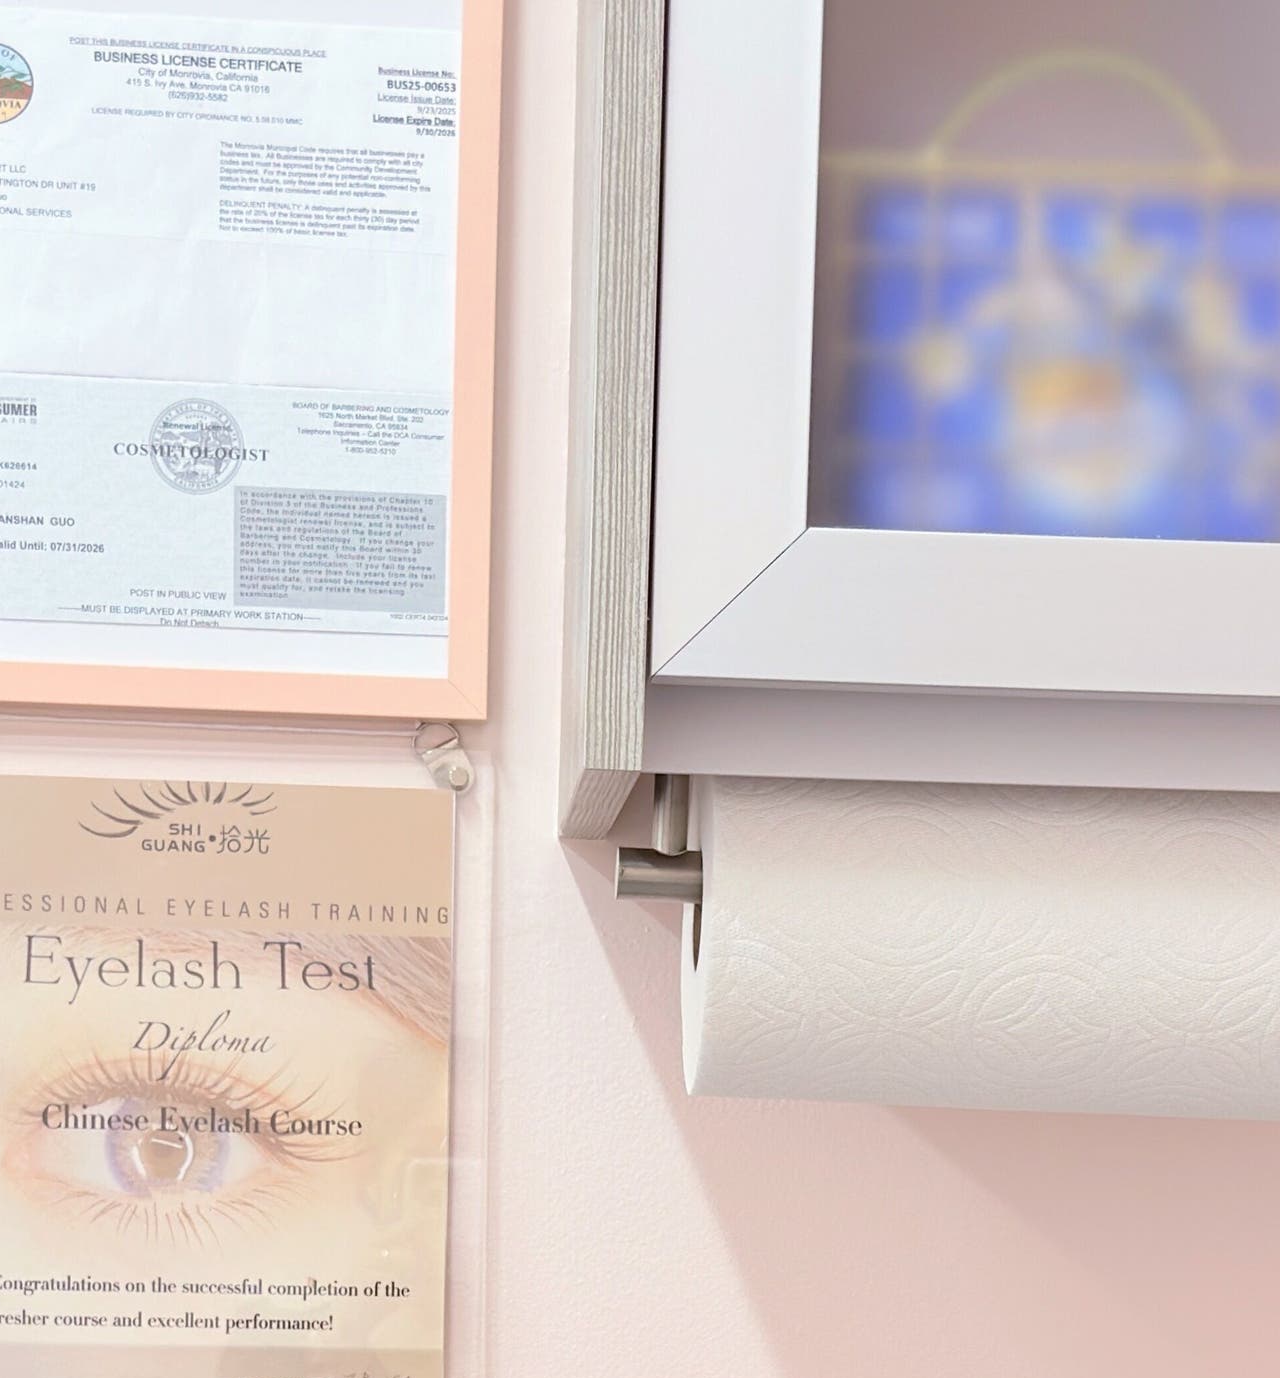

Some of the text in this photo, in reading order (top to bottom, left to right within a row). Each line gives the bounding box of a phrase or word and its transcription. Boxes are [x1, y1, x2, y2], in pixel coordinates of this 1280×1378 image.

[93, 50, 302, 73] BUSINESS LICENSE CERTIFICATE
[137, 66, 258, 82] City of Monrovia, California
[126, 77, 142, 86] 415
[154, 80, 167, 89] Ivy
[188, 82, 227, 91] Monrovia
[228, 83, 242, 92] CA
[244, 84, 270, 94] 91016
[386, 80, 456, 92] BUS25-00653
[372, 114, 404, 125] License
[8, 164, 26, 174] LLC
[40, 179, 54, 189] DR
[56, 180, 77, 190] UNIT
[79, 182, 96, 191] #19
[25, 207, 72, 218] SERVICES
[375, 405, 392, 413] AND
[392, 405, 449, 416] COSMETOLOGY
[113, 442, 269, 462] COSMETOLOGIST
[49, 516, 75, 527] GUO
[19, 540, 47, 551] Until:
[49, 541, 104, 553] 07/31/2026
[129, 587, 226, 600] POST IN PUBLIC VIEW
[81, 604, 303, 621] MUST BE DISPLAYED AT PRIMARY WORK STATION
[168, 823, 202, 836] SHI
[141, 839, 205, 853] GUANG
[218, 825, 271, 855] 拾光
[166, 897, 289, 920] EYELASH
[311, 902, 450, 925] TRAINING
[23, 934, 378, 1005] Eyelash Test
[132, 1009, 276, 1081] Diploma
[40, 1102, 363, 1138] Chinese Eyelash Course
[125, 1281, 145, 1293] on
[151, 1277, 176, 1293] the
[182, 1278, 262, 1295] successful
[267, 1279, 358, 1297] completion
[363, 1280, 381, 1297] of
[384, 1281, 410, 1298] the
[53, 1315, 107, 1327] course
[112, 1311, 142, 1328] and
[147, 1312, 219, 1329] excellent
[224, 1314, 334, 1334] performance!
